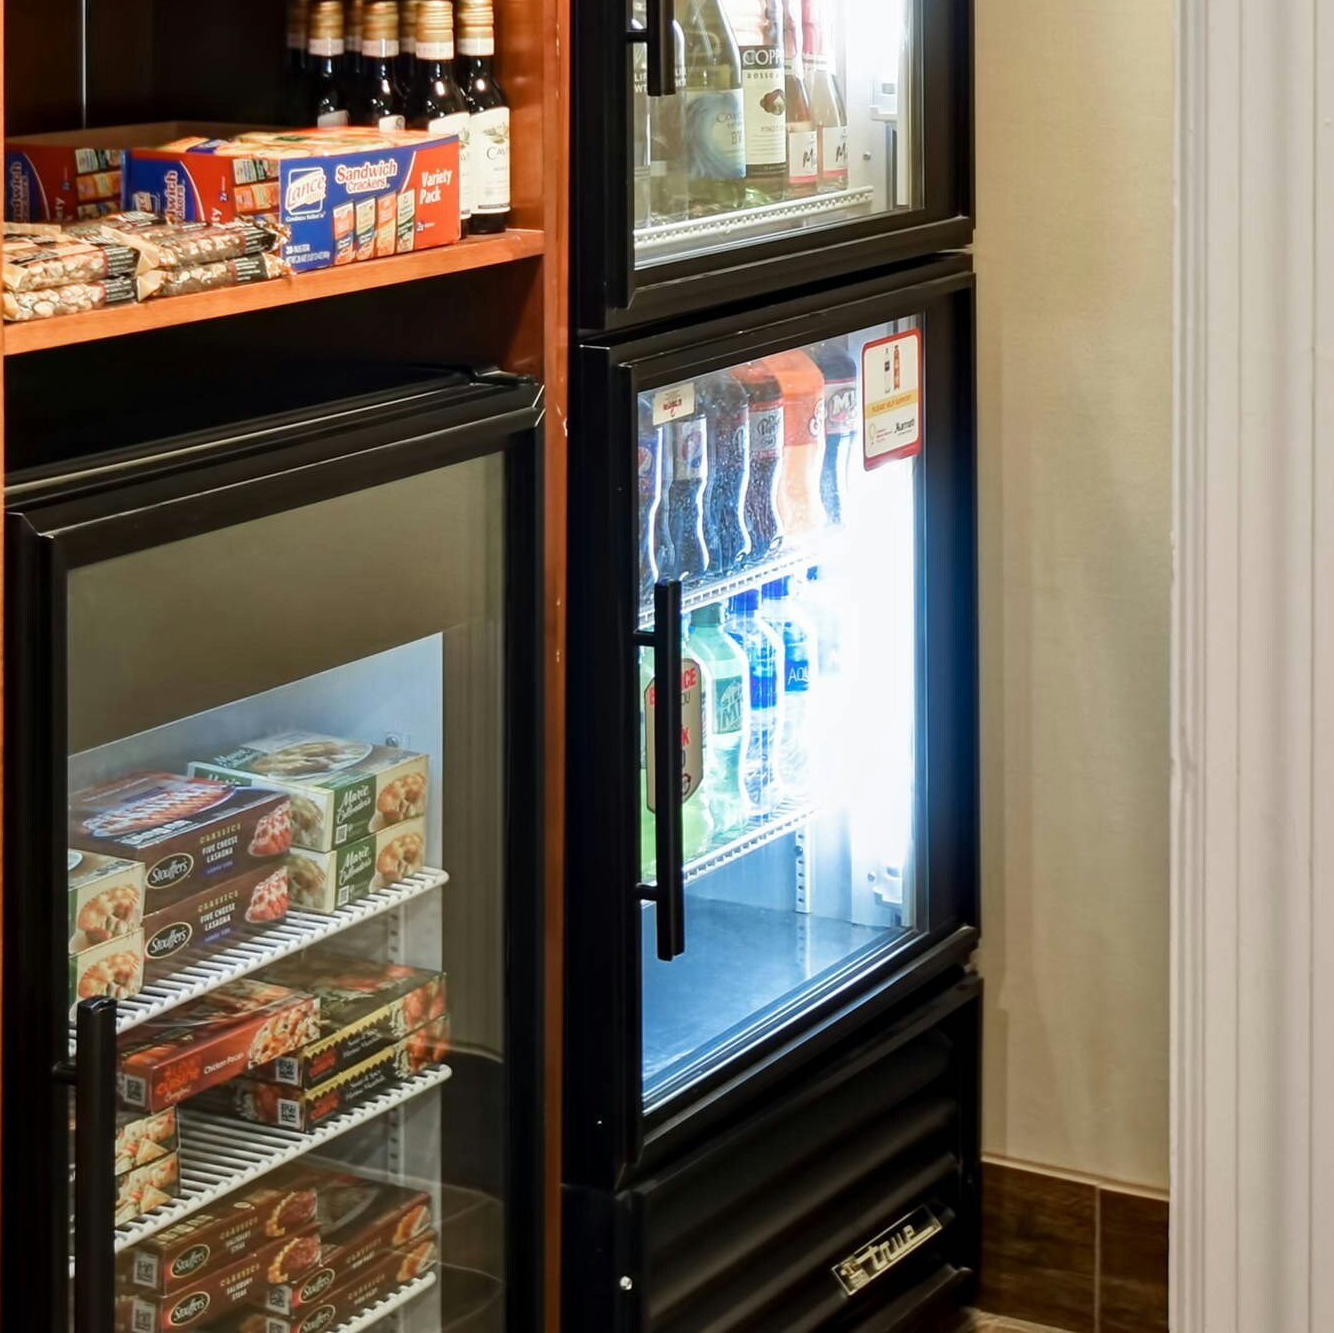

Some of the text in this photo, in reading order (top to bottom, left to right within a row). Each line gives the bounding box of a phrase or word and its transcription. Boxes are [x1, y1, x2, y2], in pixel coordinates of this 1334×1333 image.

[335, 158, 398, 184] Sandwich
[420, 168, 453, 188] Variety
[285, 174, 327, 209] Lance
[345, 177, 390, 195] Crackers
[419, 186, 442, 205] Pack
[198, 822, 242, 846] CLASSICS
[202, 835, 239, 856] FIVE CHEESE
[206, 847, 235, 864] LASAGNA
[150, 856, 189, 885] Stouffer's
[197, 889, 240, 913] CLASSICS
[199, 901, 236, 924] FIVE CHEESE
[203, 914, 232, 932] LASAGNA
[150, 925, 188, 955] Stouffer's
[202, 1057, 226, 1076] Chicken
[175, 1249, 206, 1275] Stouffer's
[219, 1262, 261, 1288] CLASSICS
[173, 1295, 206, 1322] Stouffer's
